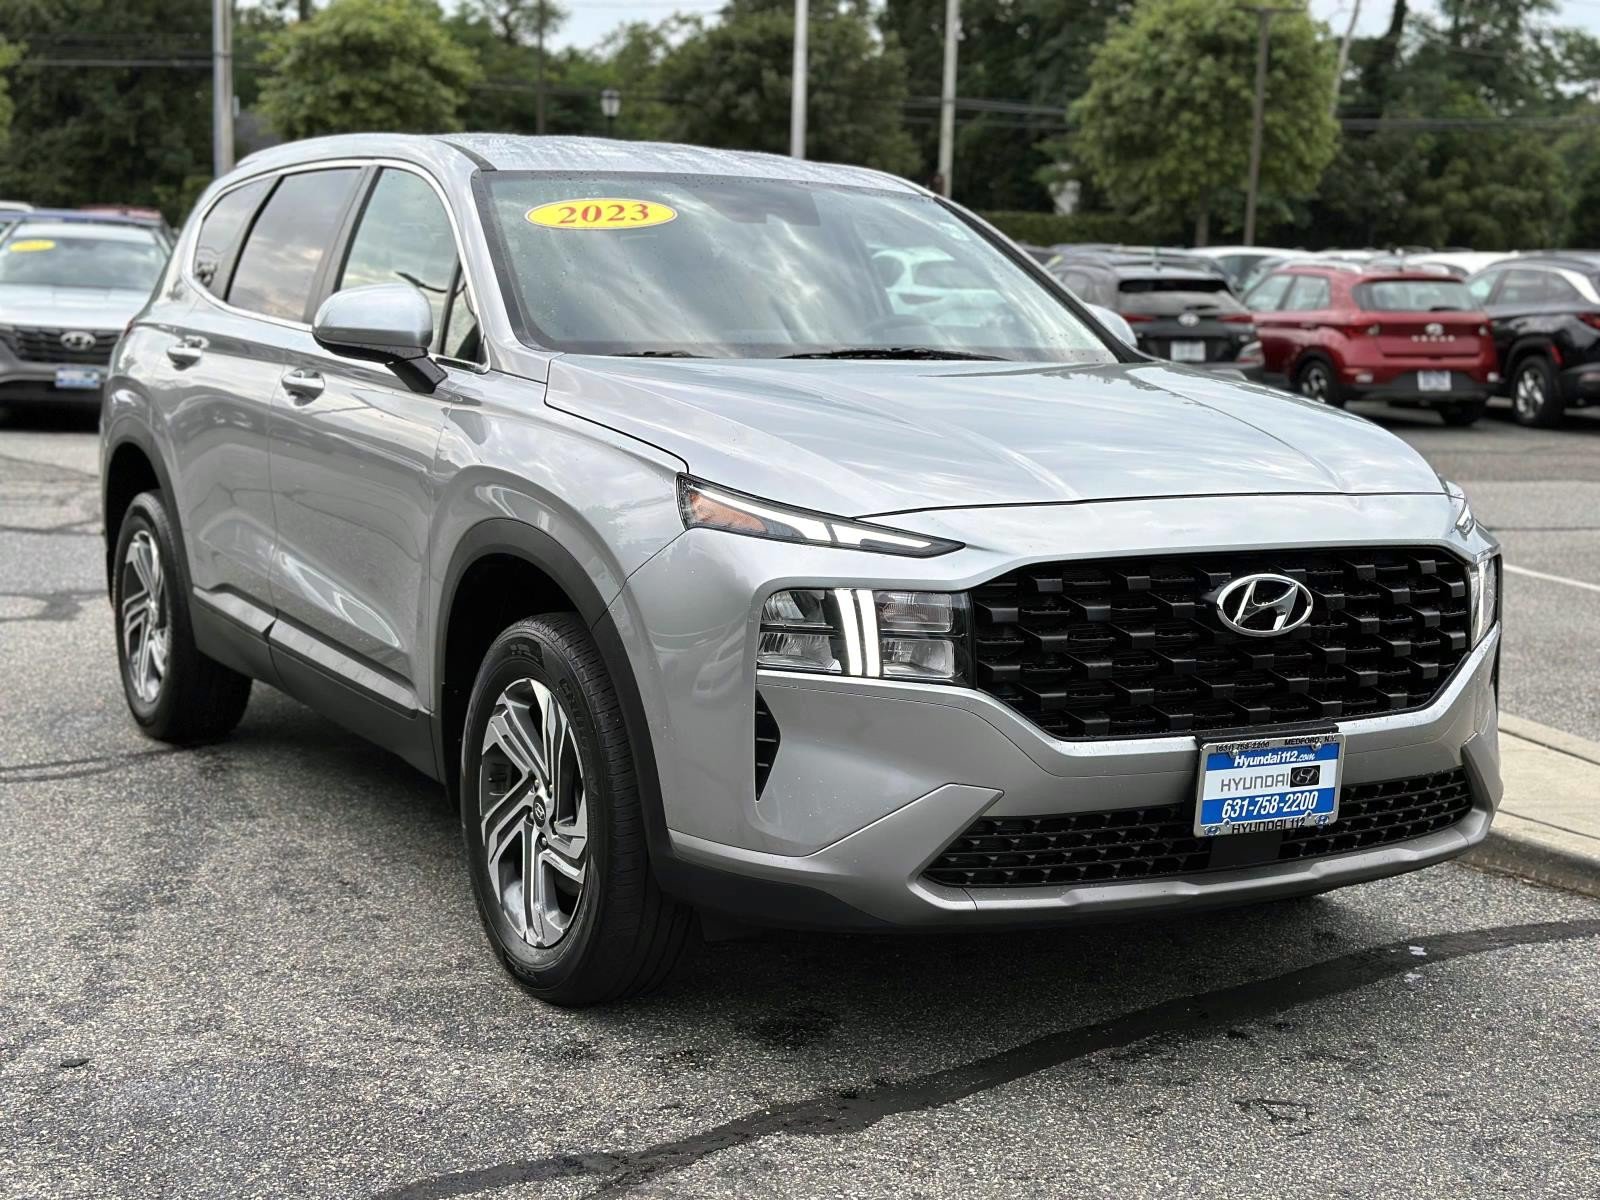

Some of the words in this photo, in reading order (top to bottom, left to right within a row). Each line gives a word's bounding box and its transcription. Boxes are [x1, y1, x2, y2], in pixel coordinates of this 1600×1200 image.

[558, 203, 649, 224] 2023
[1234, 750, 1316, 768] Hyundai112.com
[1220, 772, 1289, 792] HYUNDAI
[1222, 791, 1319, 819] 631-758-2200
[1231, 819, 1286, 835] HYUNDAI
[1289, 816, 1306, 830] 112
